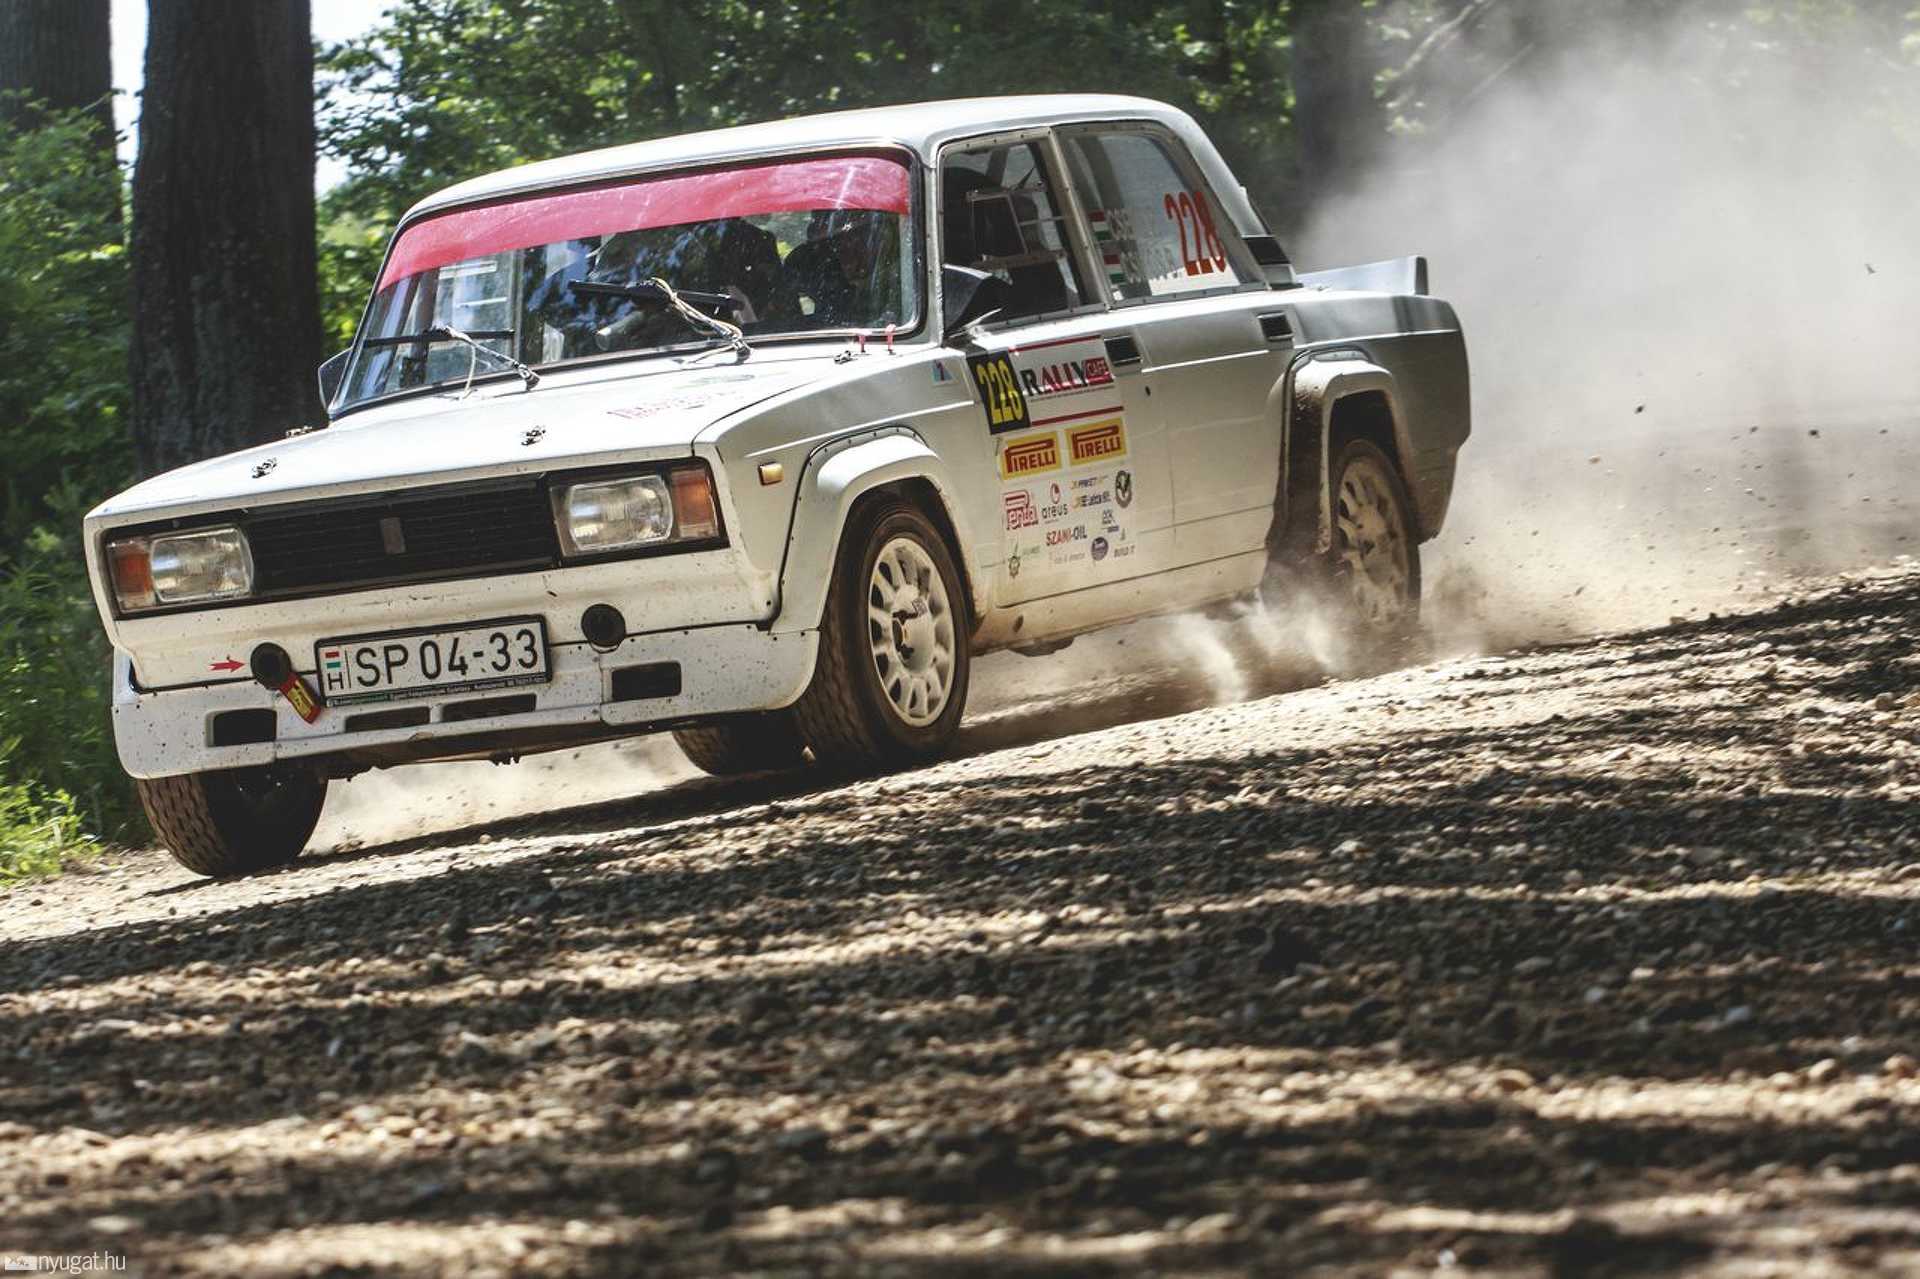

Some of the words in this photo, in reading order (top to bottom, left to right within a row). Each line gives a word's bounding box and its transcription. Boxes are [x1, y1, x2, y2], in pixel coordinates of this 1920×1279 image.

[1164, 191, 1226, 276] 228
[976, 359, 1024, 425] 228
[1020, 361, 1089, 396] RALLY
[1004, 439, 1057, 474] PIRELLI
[1071, 425, 1121, 460] PIRELLI
[327, 672, 344, 691] H
